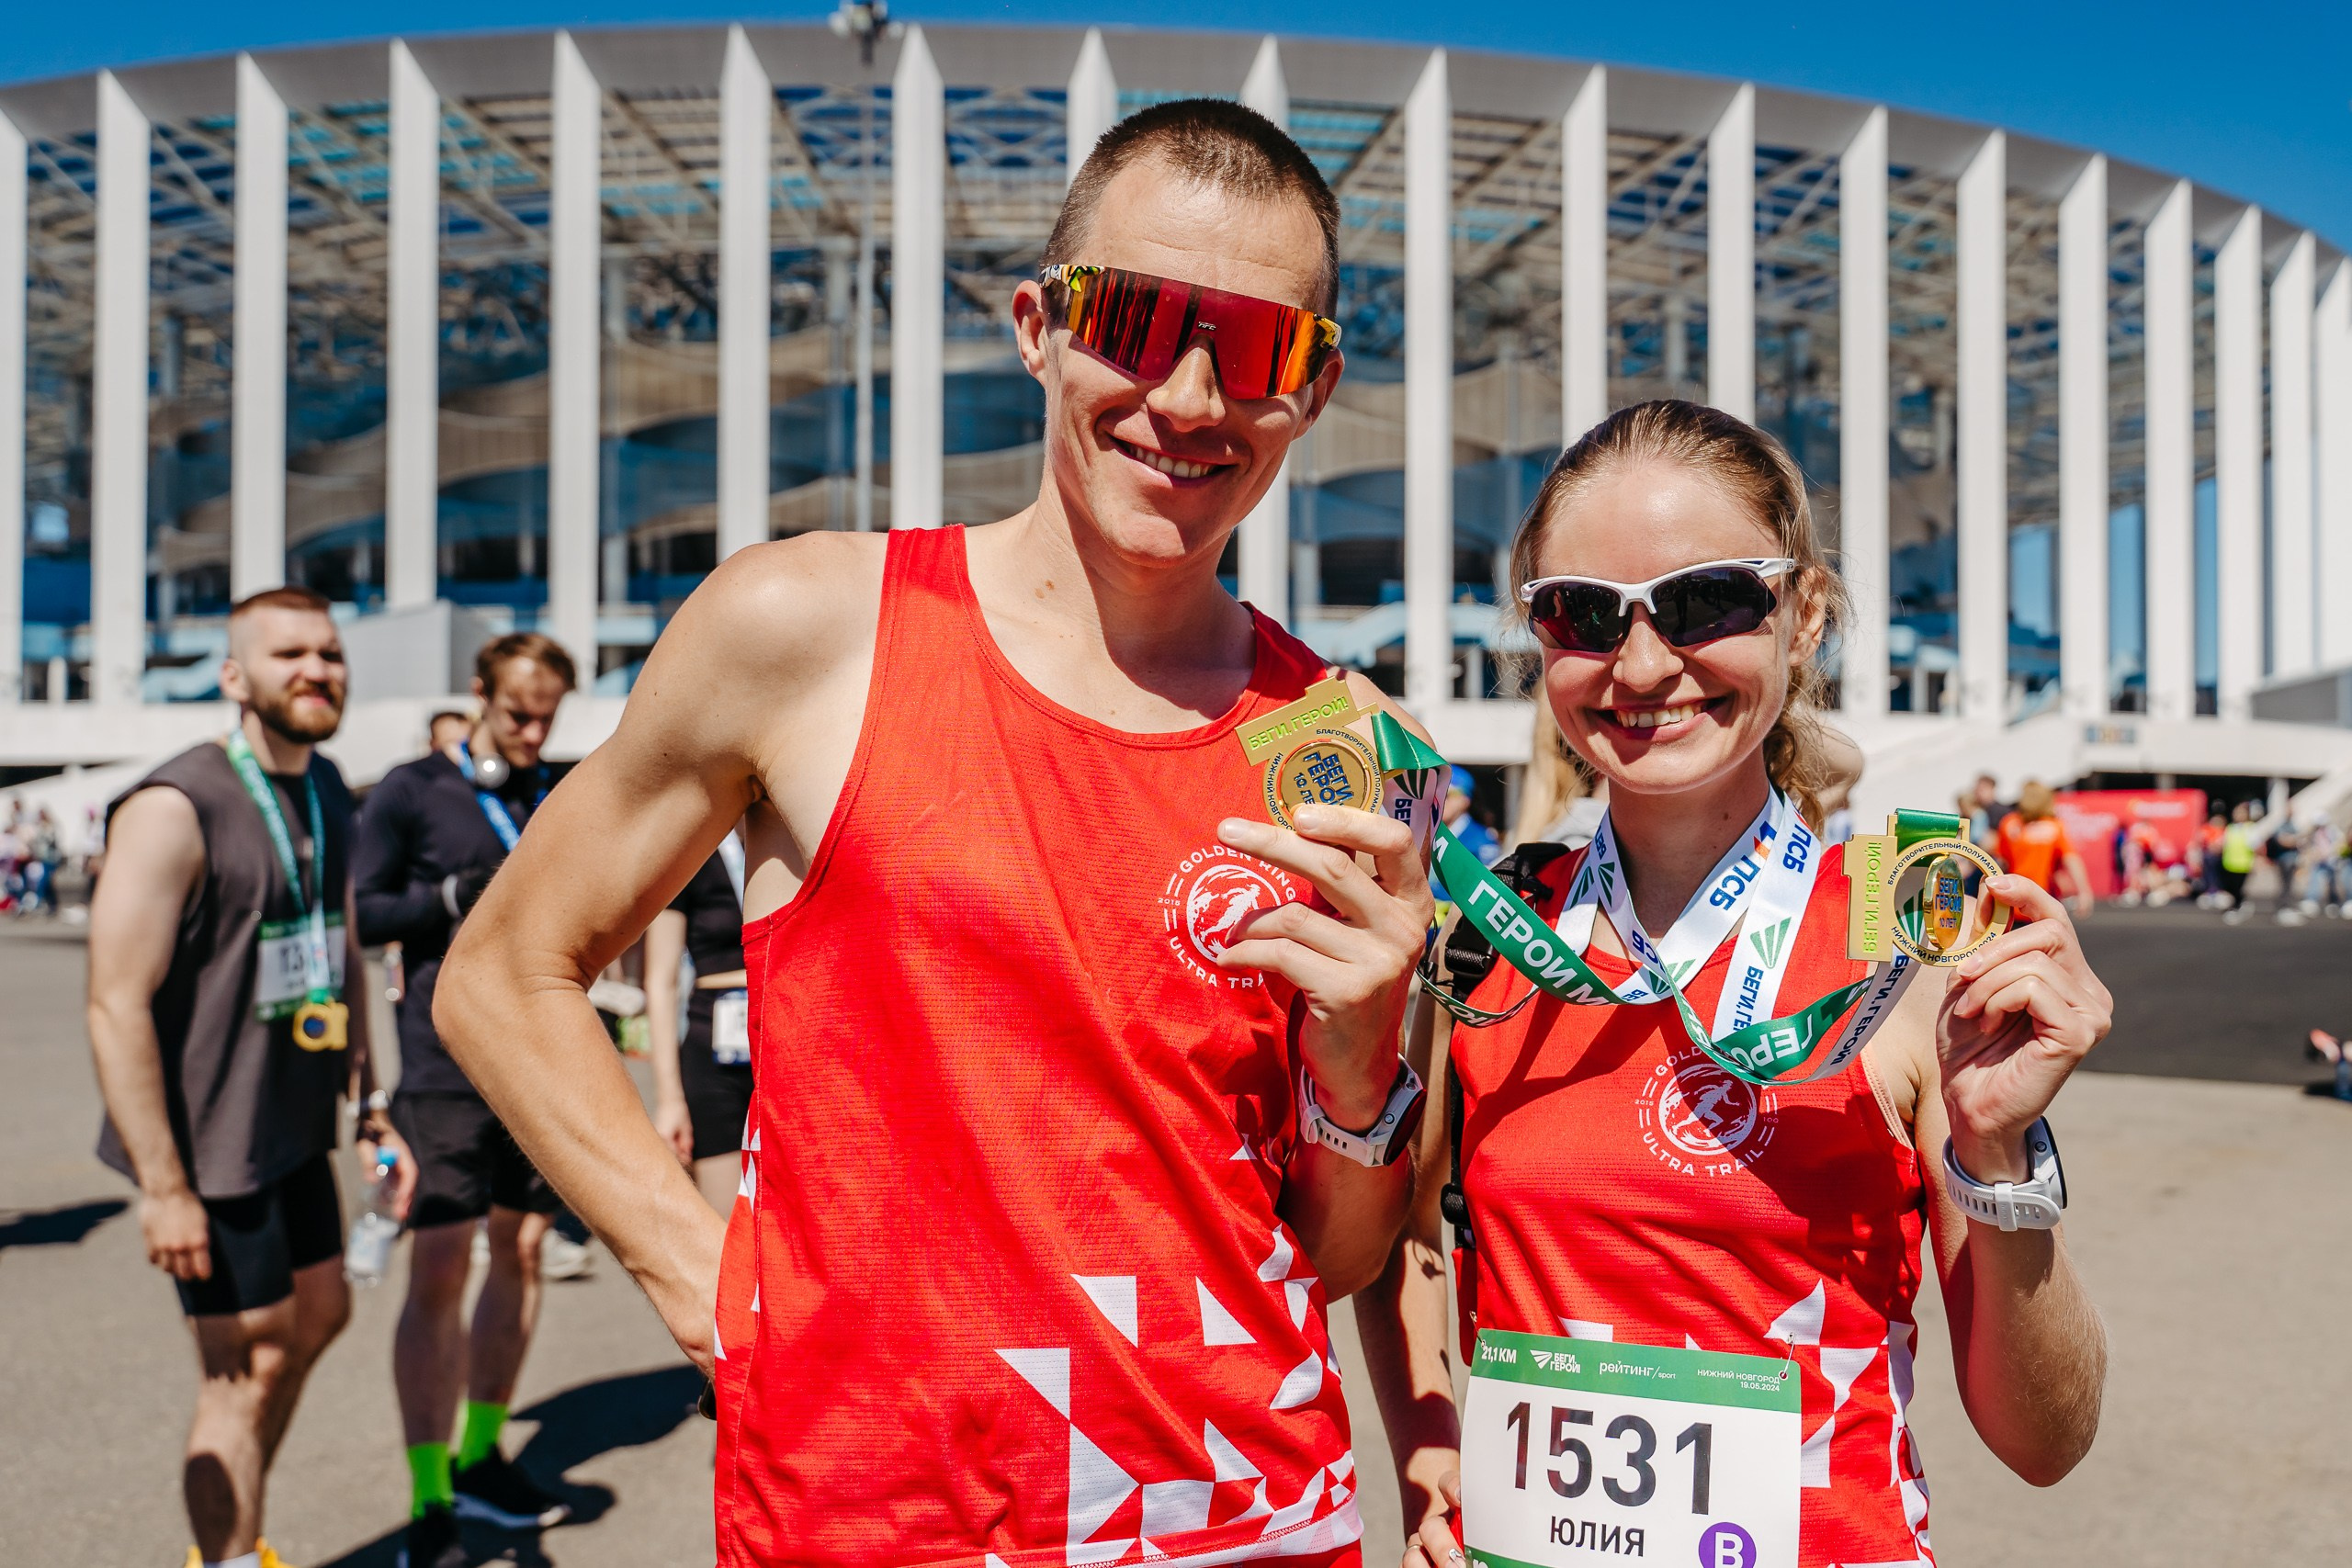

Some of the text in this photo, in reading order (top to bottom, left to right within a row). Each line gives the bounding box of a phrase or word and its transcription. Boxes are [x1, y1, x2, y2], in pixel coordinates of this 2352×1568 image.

[1248, 696, 1350, 750] БЕГИ, ГЕРОЙ!
[1266, 751, 1297, 832] НИЖНИЙ НОВГОРО
[1294, 772, 1316, 806] 10 ЛЕ
[1303, 750, 1339, 806] ГЕРО
[1317, 728, 1381, 814] БЛАГОТВОРИТЕЛЬНЫЙ ПОЛУМАР
[1782, 824, 1812, 874] ПСБ
[1887, 842, 1998, 886] БЛАГОТВОРИТЕЛЬНЫЙ ПОЛУМАРА
[1709, 854, 1761, 911] ПСБ
[1863, 841, 1883, 953] БЕГИ, ГЕРОЙ!
[1170, 936, 1218, 987] ULTRA
[1891, 926, 1927, 959] НИЖНИЙ
[1735, 965, 1764, 1009] БЕГИ,
[1656, 1046, 1702, 1076] GOLD
[1731, 1013, 1814, 1072] ГЕРО
[1634, 1099, 1655, 1107] 2015
[1763, 1116, 1780, 1124] 100
[1643, 1131, 1764, 1178] ULTRA TRAIL
[1481, 1346, 1498, 1363] 21,1
[1550, 1360, 1580, 1373] ГЕРОЙ!
[1554, 1352, 1577, 1364] БЕГИ,
[1697, 1369, 1781, 1385] НИЖНИЙ НОВГОРОД
[1740, 1381, 1781, 1392] 19.05.2024
[1506, 1401, 1713, 1515] 1531
[1550, 1515, 1645, 1557] ЮЛИЯ
